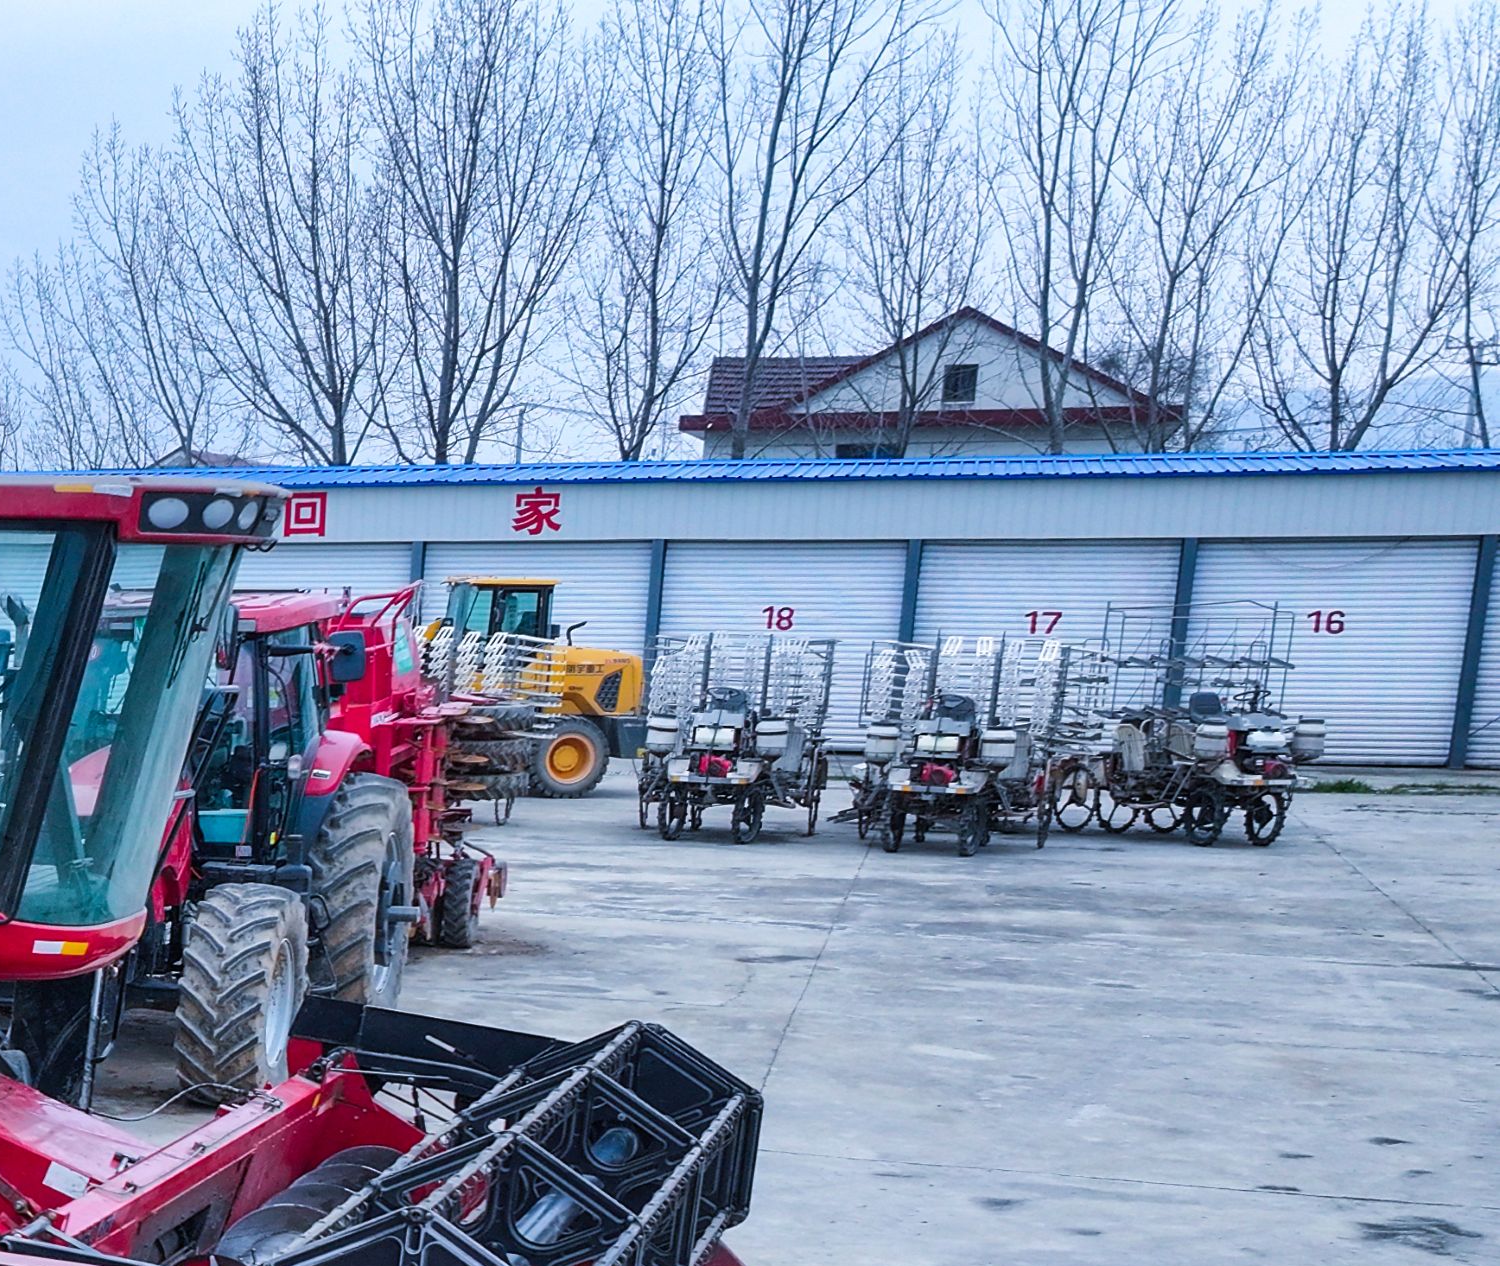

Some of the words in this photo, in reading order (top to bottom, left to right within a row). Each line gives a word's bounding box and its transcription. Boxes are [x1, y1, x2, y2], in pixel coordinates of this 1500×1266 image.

[762, 605, 795, 631] 18
[1024, 610, 1063, 634] 17
[1307, 610, 1346, 635] 16
